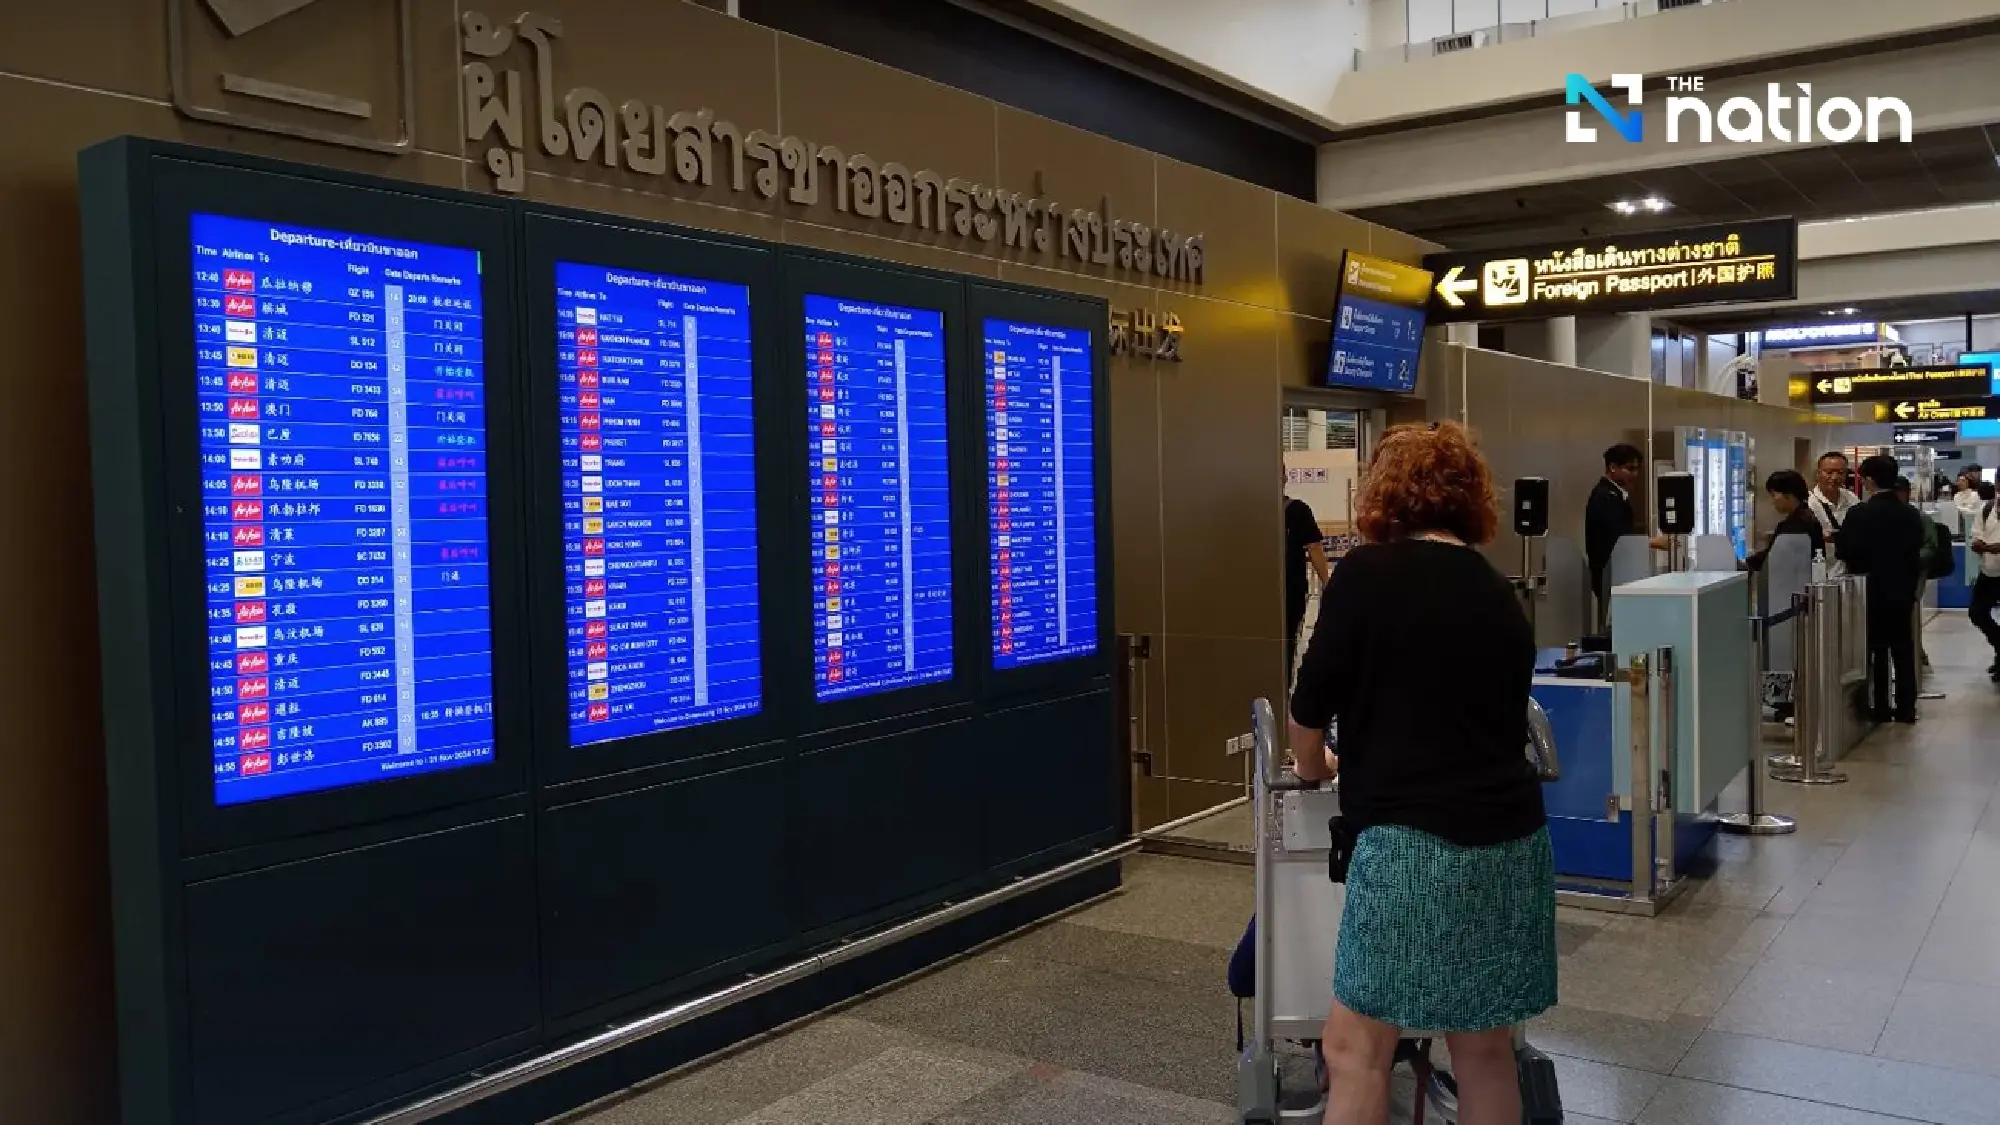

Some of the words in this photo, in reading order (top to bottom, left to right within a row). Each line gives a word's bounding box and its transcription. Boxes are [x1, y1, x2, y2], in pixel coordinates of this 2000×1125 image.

[462, 10, 1205, 284] ผู้โดยสารขาออกระหว่างประเทศ
[1534, 234, 1740, 275] หนังสือเดินทางต่างชาติ
[1533, 280, 1598, 300] Foreign
[1605, 268, 1688, 293] Passport
[1697, 262, 1775, 285] 外国护照
